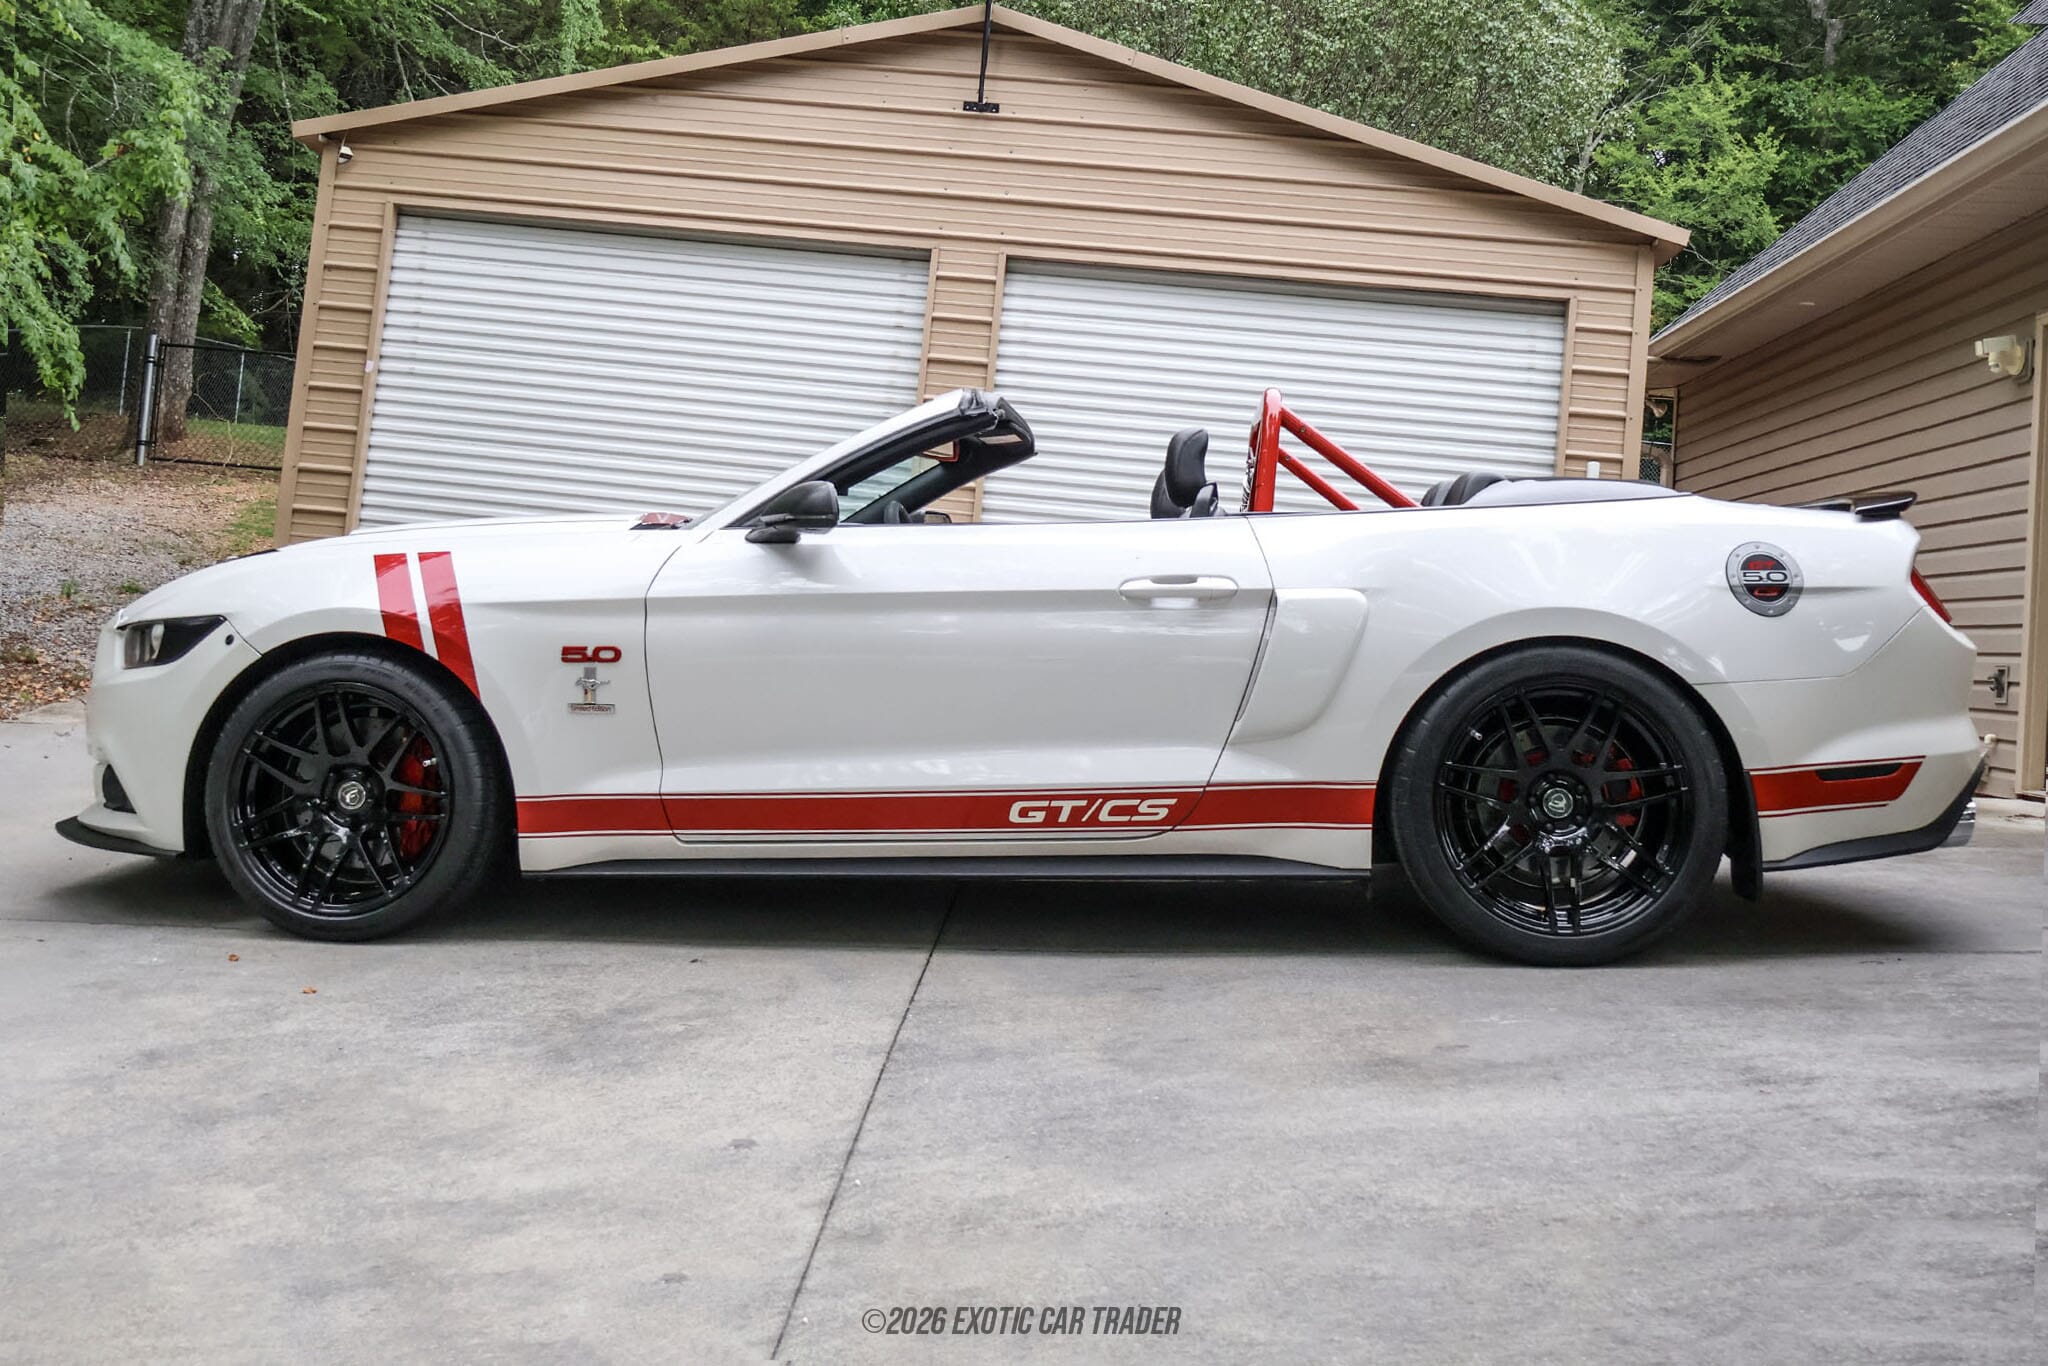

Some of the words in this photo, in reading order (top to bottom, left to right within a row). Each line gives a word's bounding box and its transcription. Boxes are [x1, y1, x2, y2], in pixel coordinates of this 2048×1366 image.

[1743, 572, 1788, 582] 5.0
[561, 646, 622, 663] 5.0
[1008, 798, 1178, 823] GT/CS
